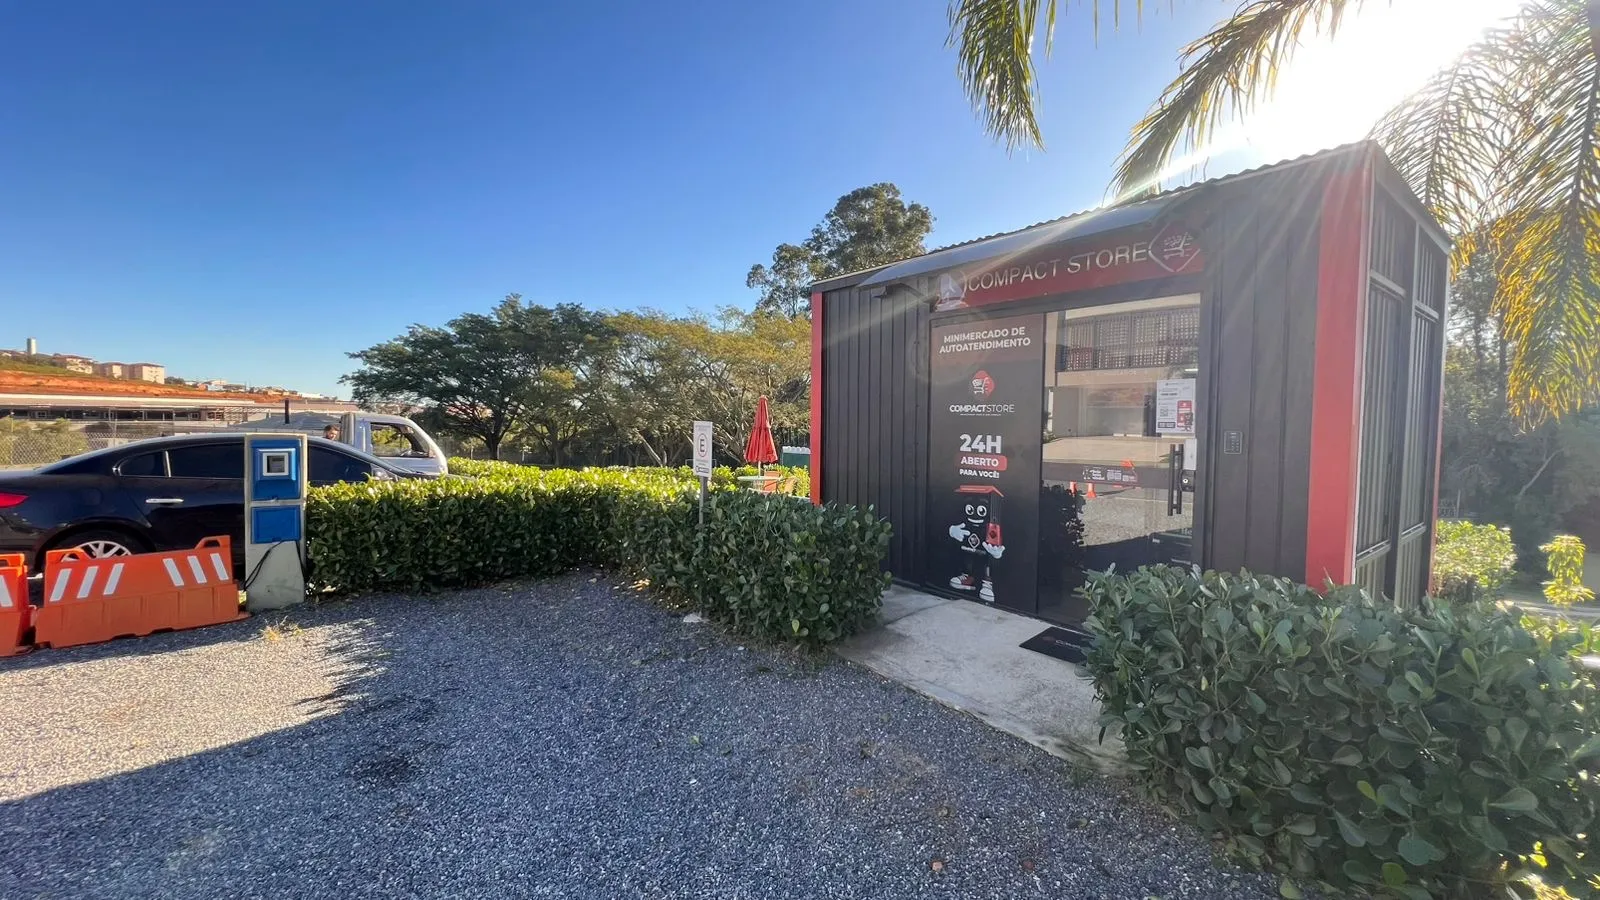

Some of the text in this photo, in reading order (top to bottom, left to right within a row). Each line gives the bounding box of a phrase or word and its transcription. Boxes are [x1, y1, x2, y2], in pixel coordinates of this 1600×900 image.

[967, 241, 1148, 292] COMPACT STORE
[943, 326, 1026, 344] MINIMERCADO DE
[939, 337, 1031, 354] AUTOATENDIMENTO
[700, 438, 705, 452] E
[959, 433, 1002, 454] 24H
[960, 456, 999, 467] ABERTO
[959, 468, 978, 477] PARA
